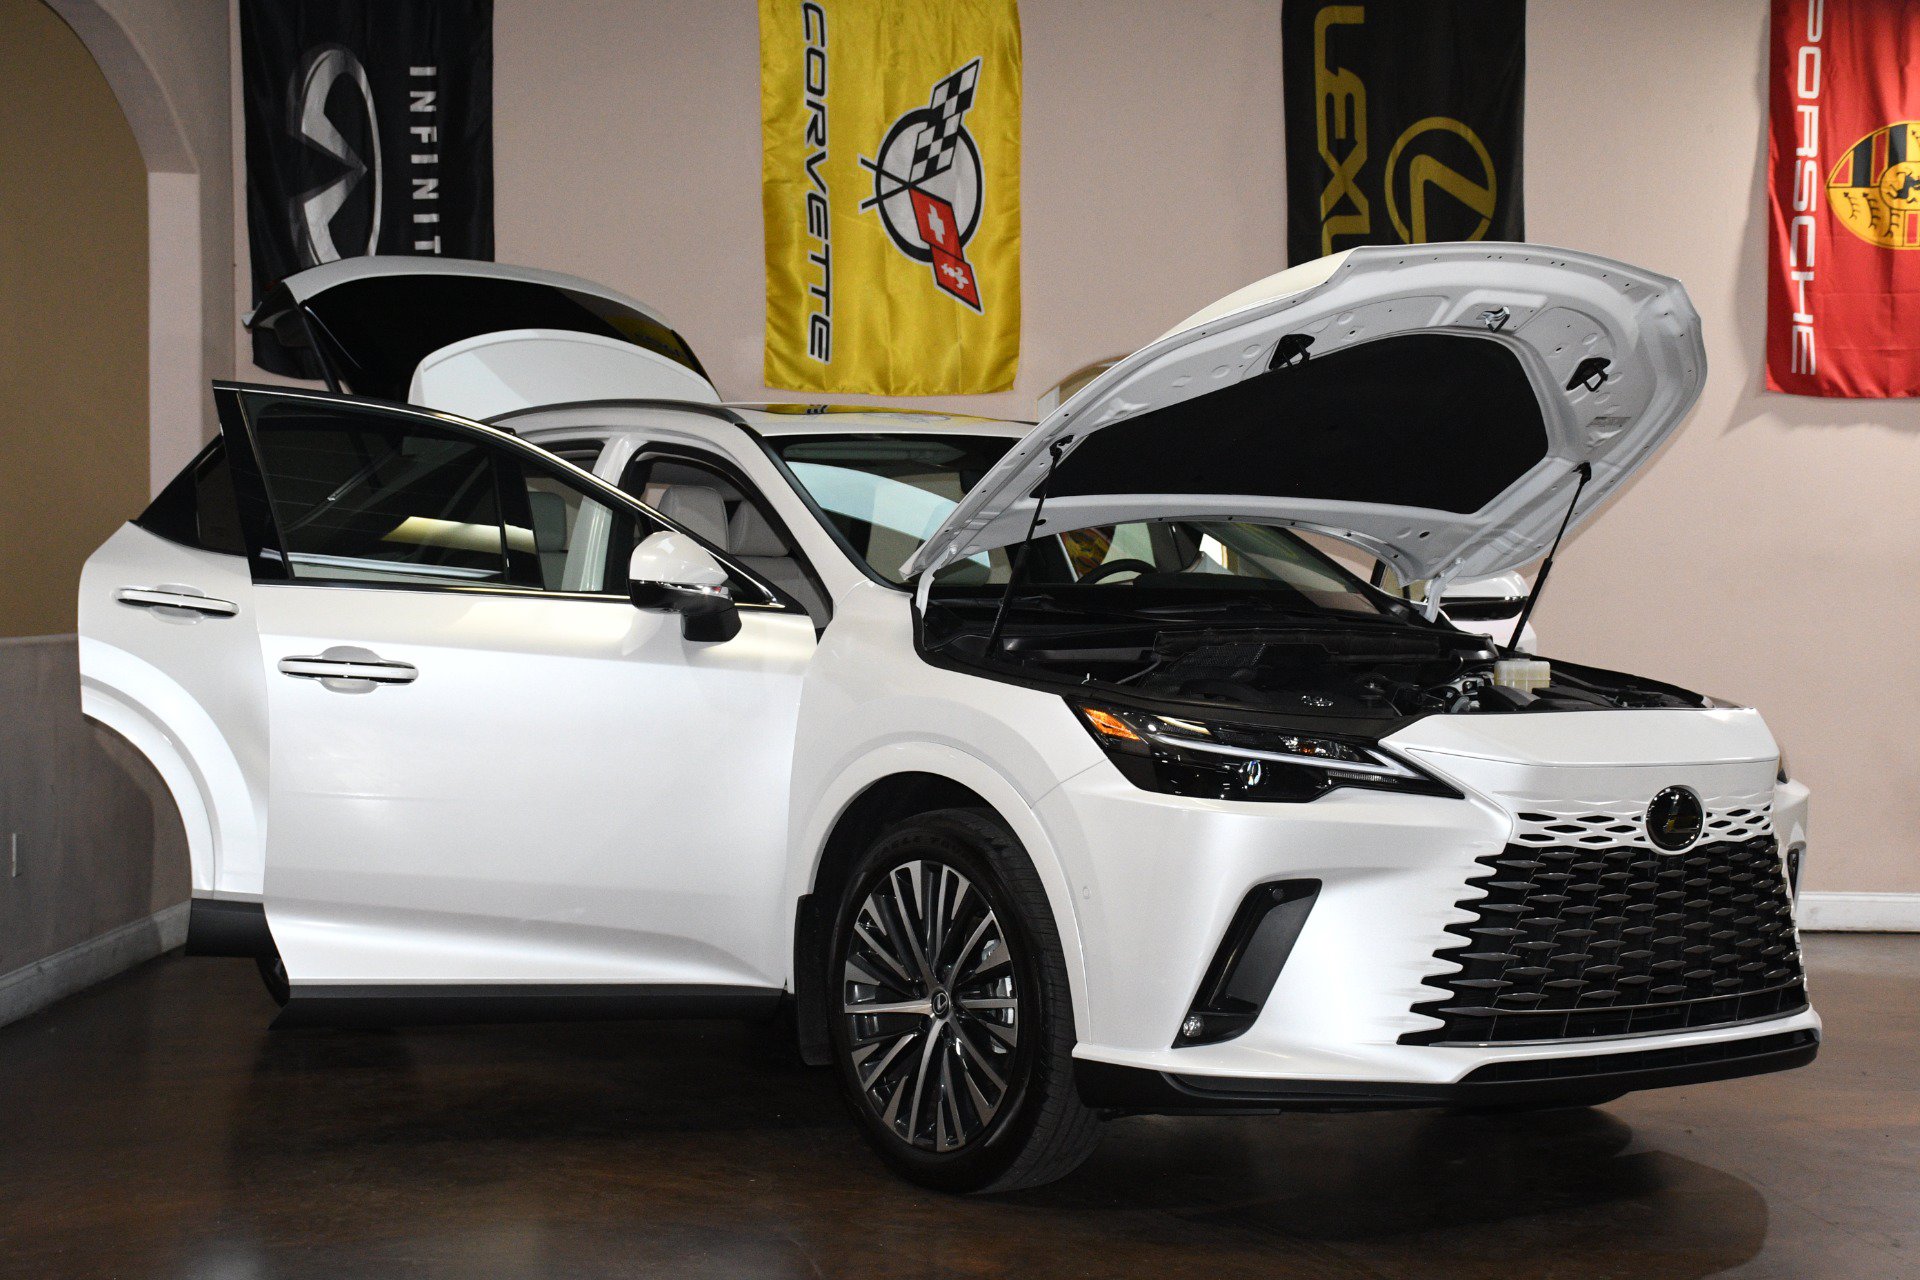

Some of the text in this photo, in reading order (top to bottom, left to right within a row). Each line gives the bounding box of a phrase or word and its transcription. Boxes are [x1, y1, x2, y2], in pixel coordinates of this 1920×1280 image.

[409, 66, 441, 254] INFINIT
[803, 1, 831, 362] CORVETTE
[1791, 0, 1823, 375] PORSCHE
